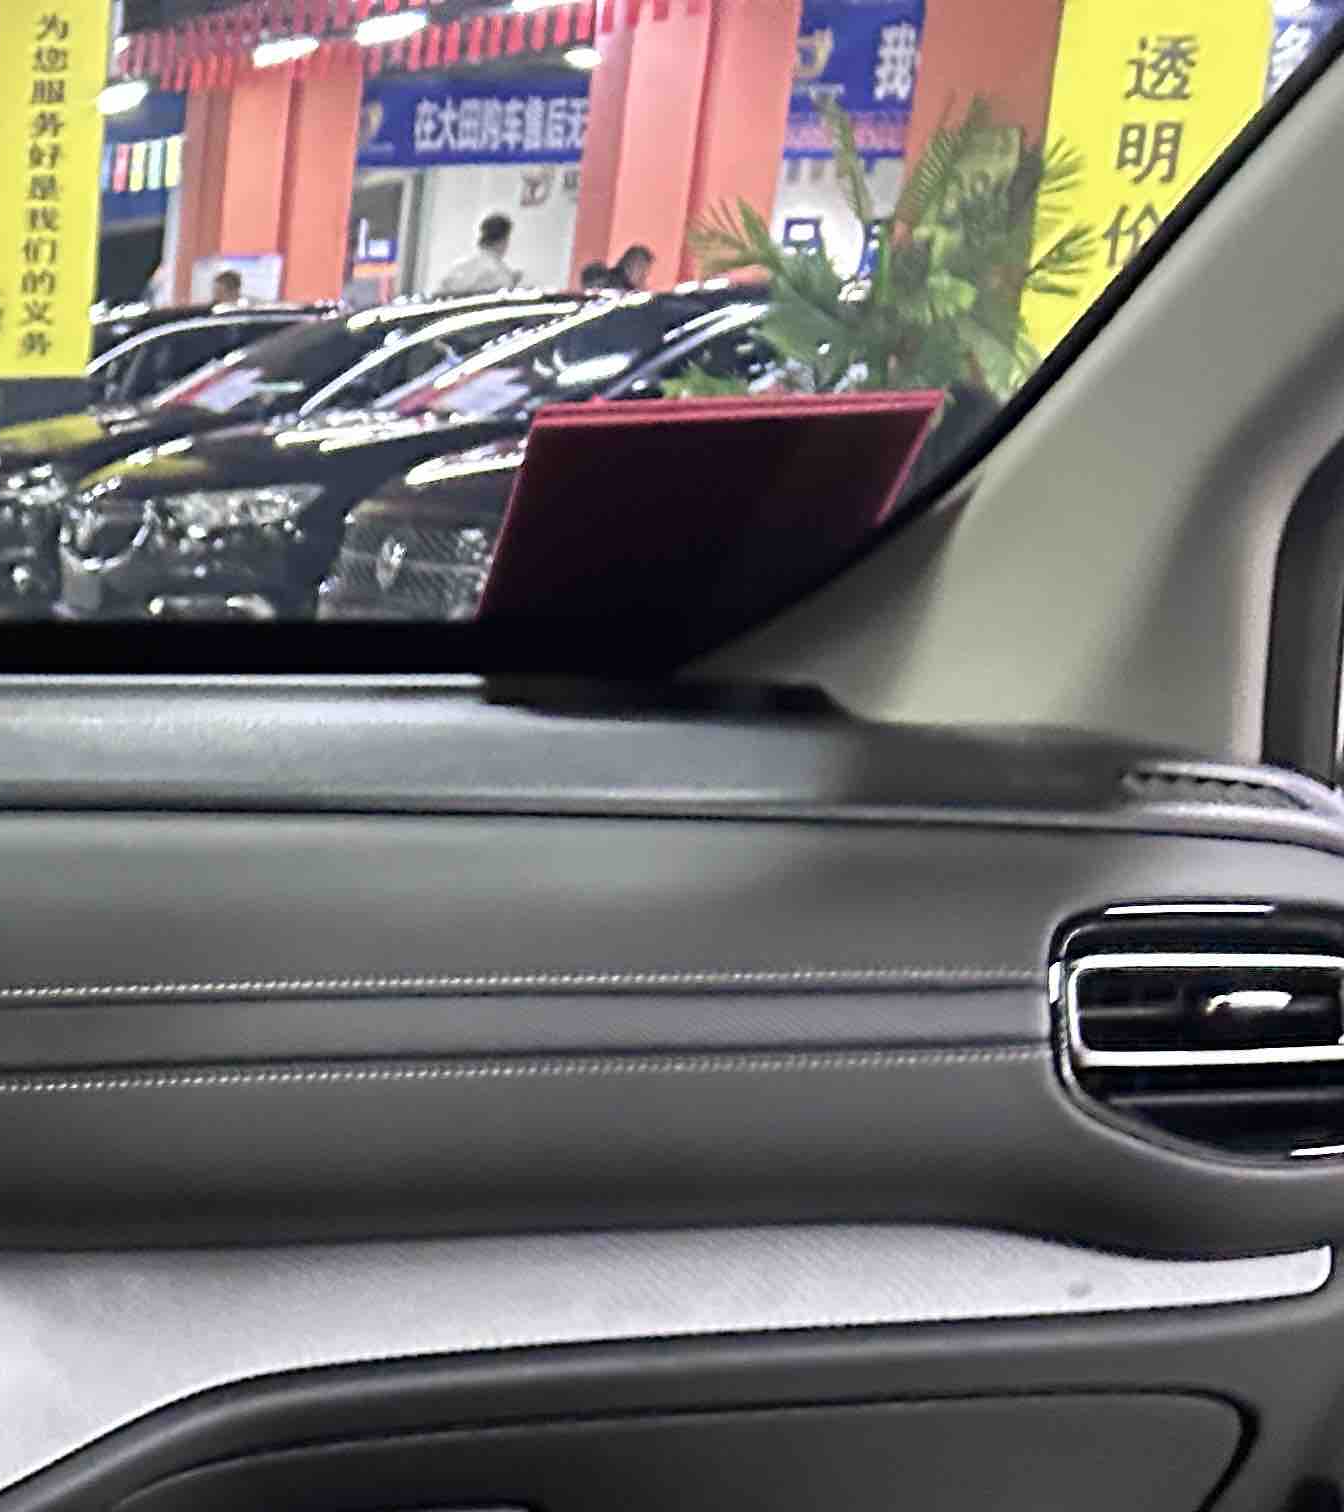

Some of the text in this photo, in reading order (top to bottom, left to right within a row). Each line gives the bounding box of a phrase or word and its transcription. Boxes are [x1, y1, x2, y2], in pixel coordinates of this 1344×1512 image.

[18, 13, 69, 357] 为您服务好是我们的义务
